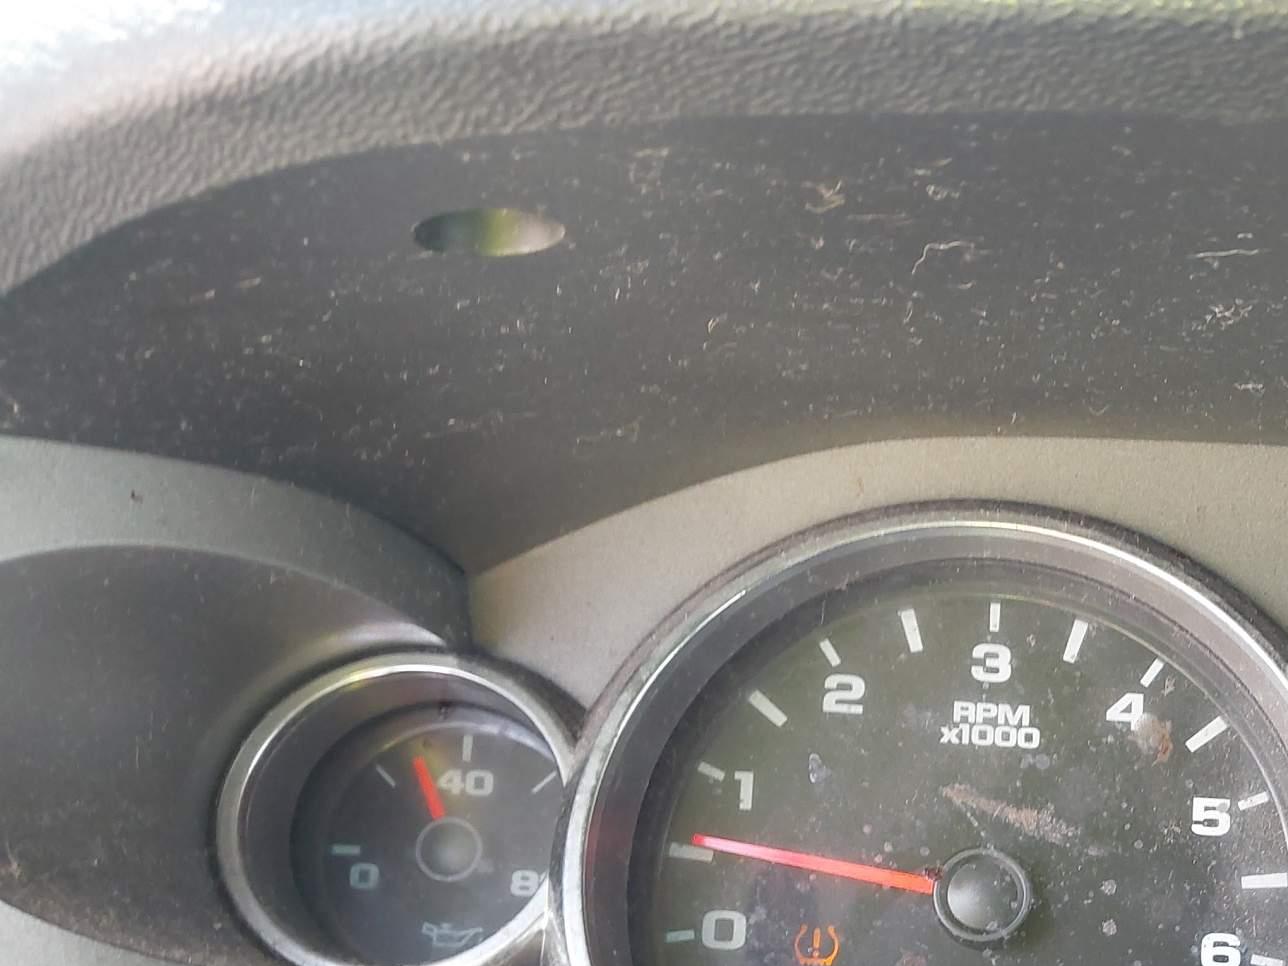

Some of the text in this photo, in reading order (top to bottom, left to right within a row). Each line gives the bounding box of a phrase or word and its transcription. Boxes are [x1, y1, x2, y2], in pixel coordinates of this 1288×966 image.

[970, 643, 1011, 683] 3
[822, 675, 864, 714] 2
[1106, 693, 1145, 731] 4
[952, 702, 1030, 726] RPM
[940, 725, 1041, 750] x1000
[438, 769, 494, 796] 40
[733, 771, 754, 810] 1
[1191, 797, 1231, 836] 5
[349, 863, 379, 889] 0
[702, 909, 746, 950] 0
